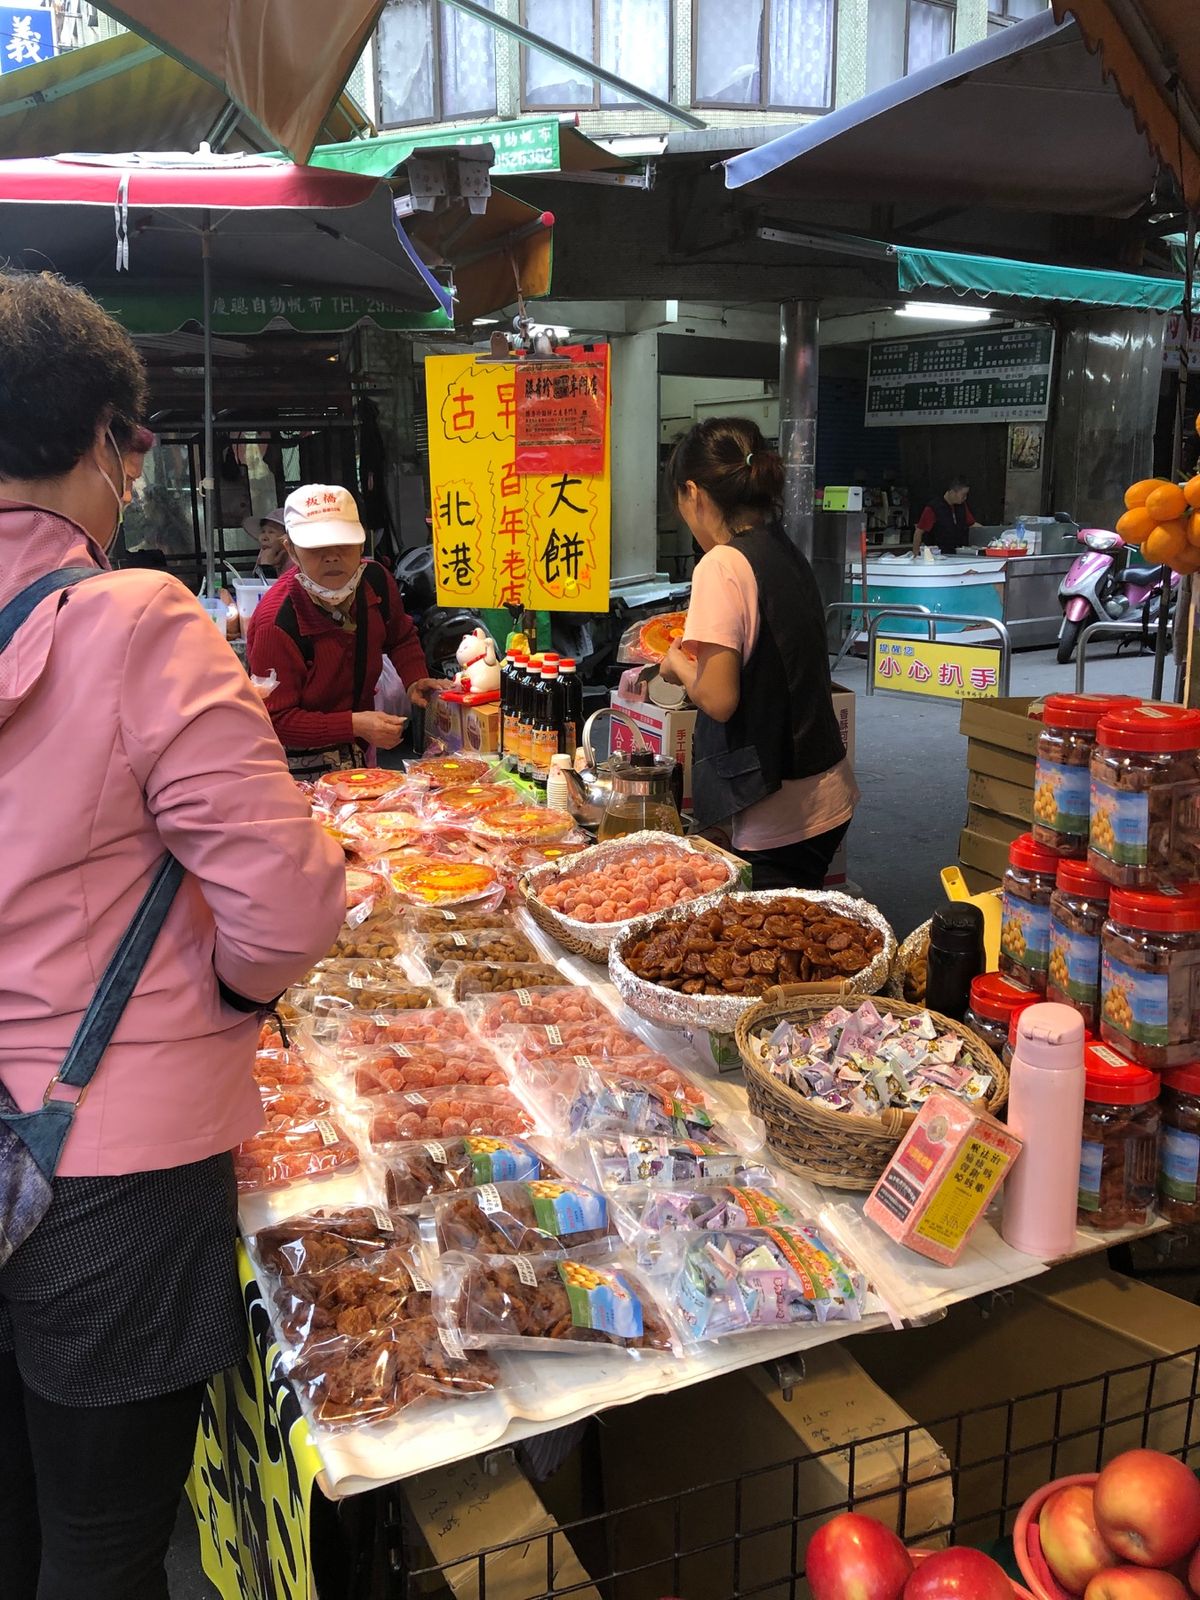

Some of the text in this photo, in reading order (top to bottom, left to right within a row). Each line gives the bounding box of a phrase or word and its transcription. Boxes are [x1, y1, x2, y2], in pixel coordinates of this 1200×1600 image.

[5, 15, 48, 63] 義
[440, 490, 475, 586] 北港
[878, 655, 996, 690] 小心扒手
